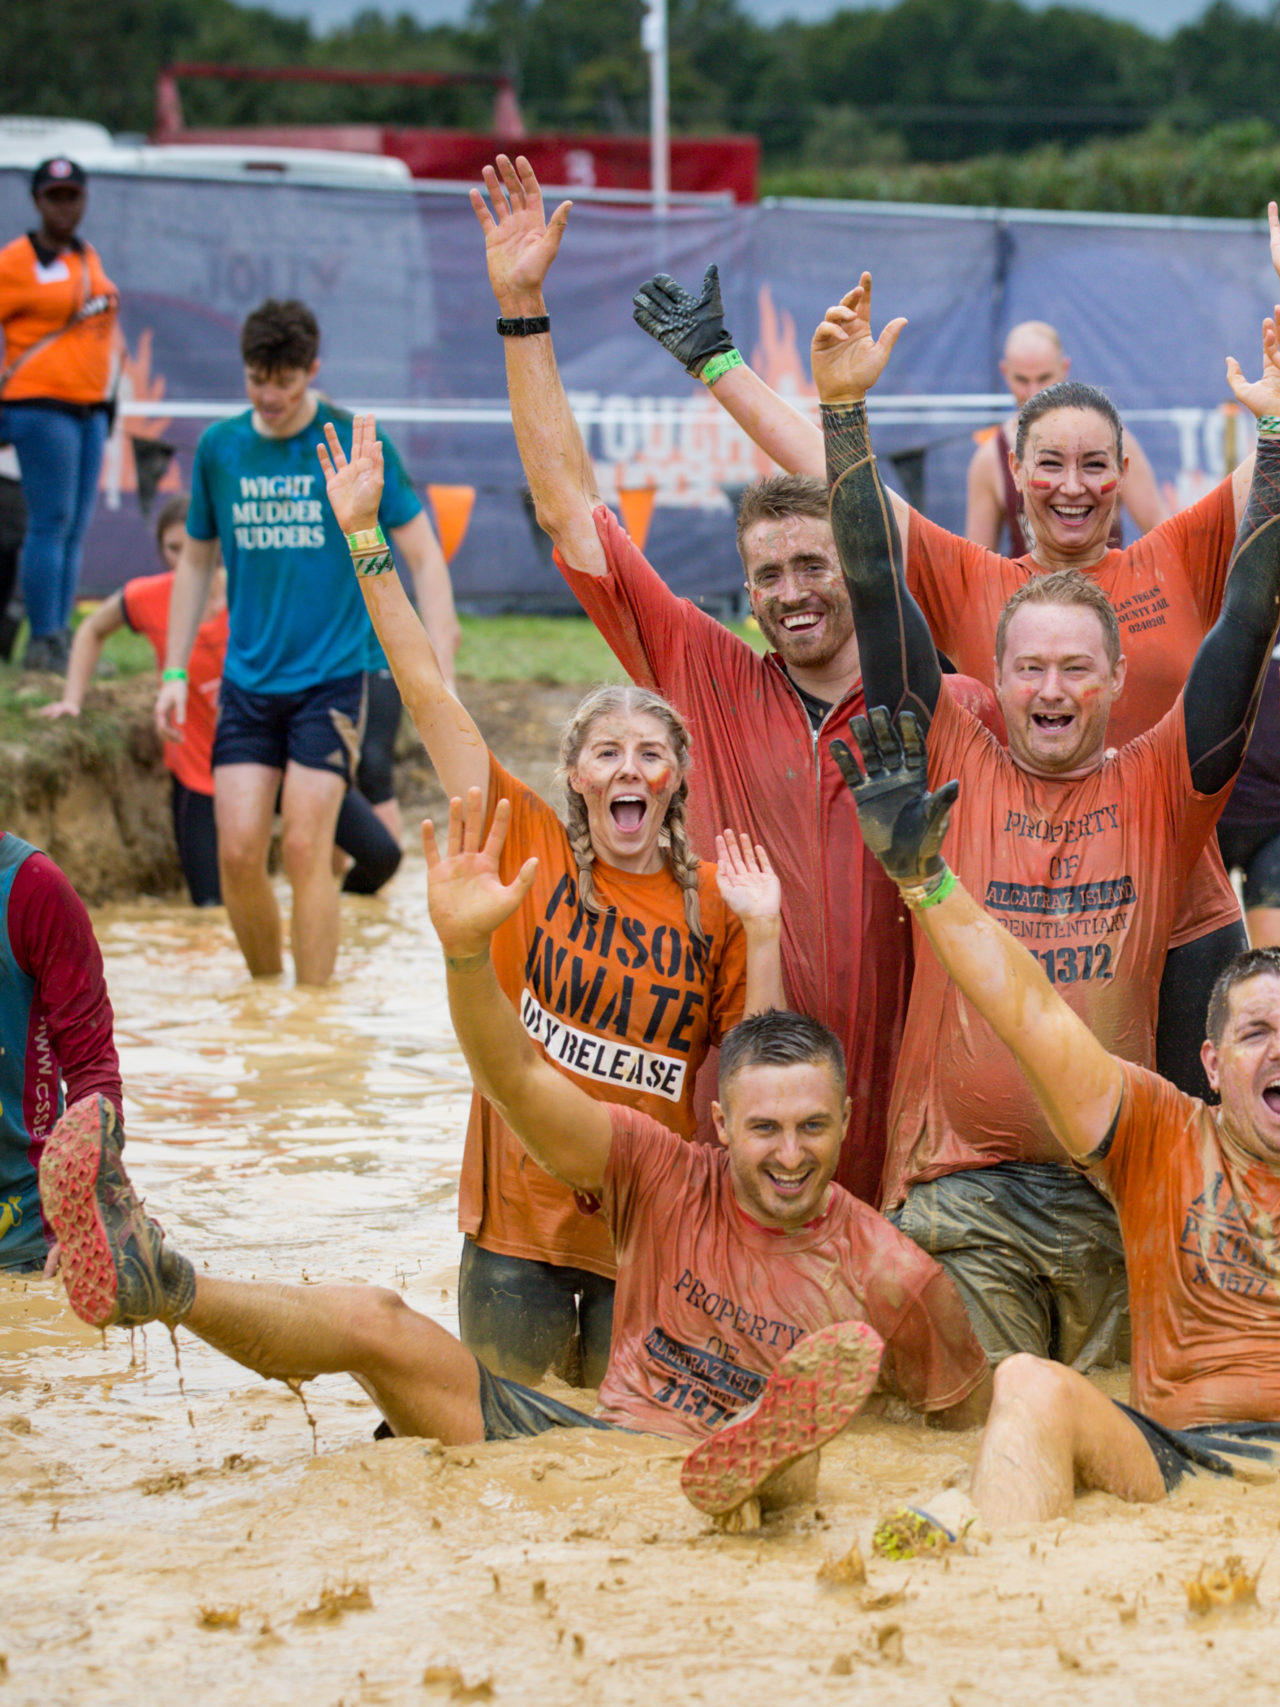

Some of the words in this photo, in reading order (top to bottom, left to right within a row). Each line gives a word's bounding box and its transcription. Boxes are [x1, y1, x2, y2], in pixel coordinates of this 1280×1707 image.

[240, 474, 316, 499] WIGHT
[231, 499, 323, 525] MUDDER
[1113, 599, 1132, 613] LAS
[1131, 585, 1161, 605] VEGAS
[1116, 605, 1151, 624] OUNTY
[1151, 597, 1171, 613] JAIL
[1004, 804, 1119, 843] PROPERTY
[1049, 854, 1080, 881] OF
[985, 885, 1075, 911] ALCATRAZ
[1079, 880, 1136, 906] ISLAND
[545, 872, 714, 986] PRISON
[997, 912, 1128, 940] PENITENTIARY
[1029, 943, 1113, 985] 1372
[525, 925, 704, 1054] INMATE
[558, 1033, 682, 1096] RELEASE
[673, 1268, 808, 1351] PROPERTY
